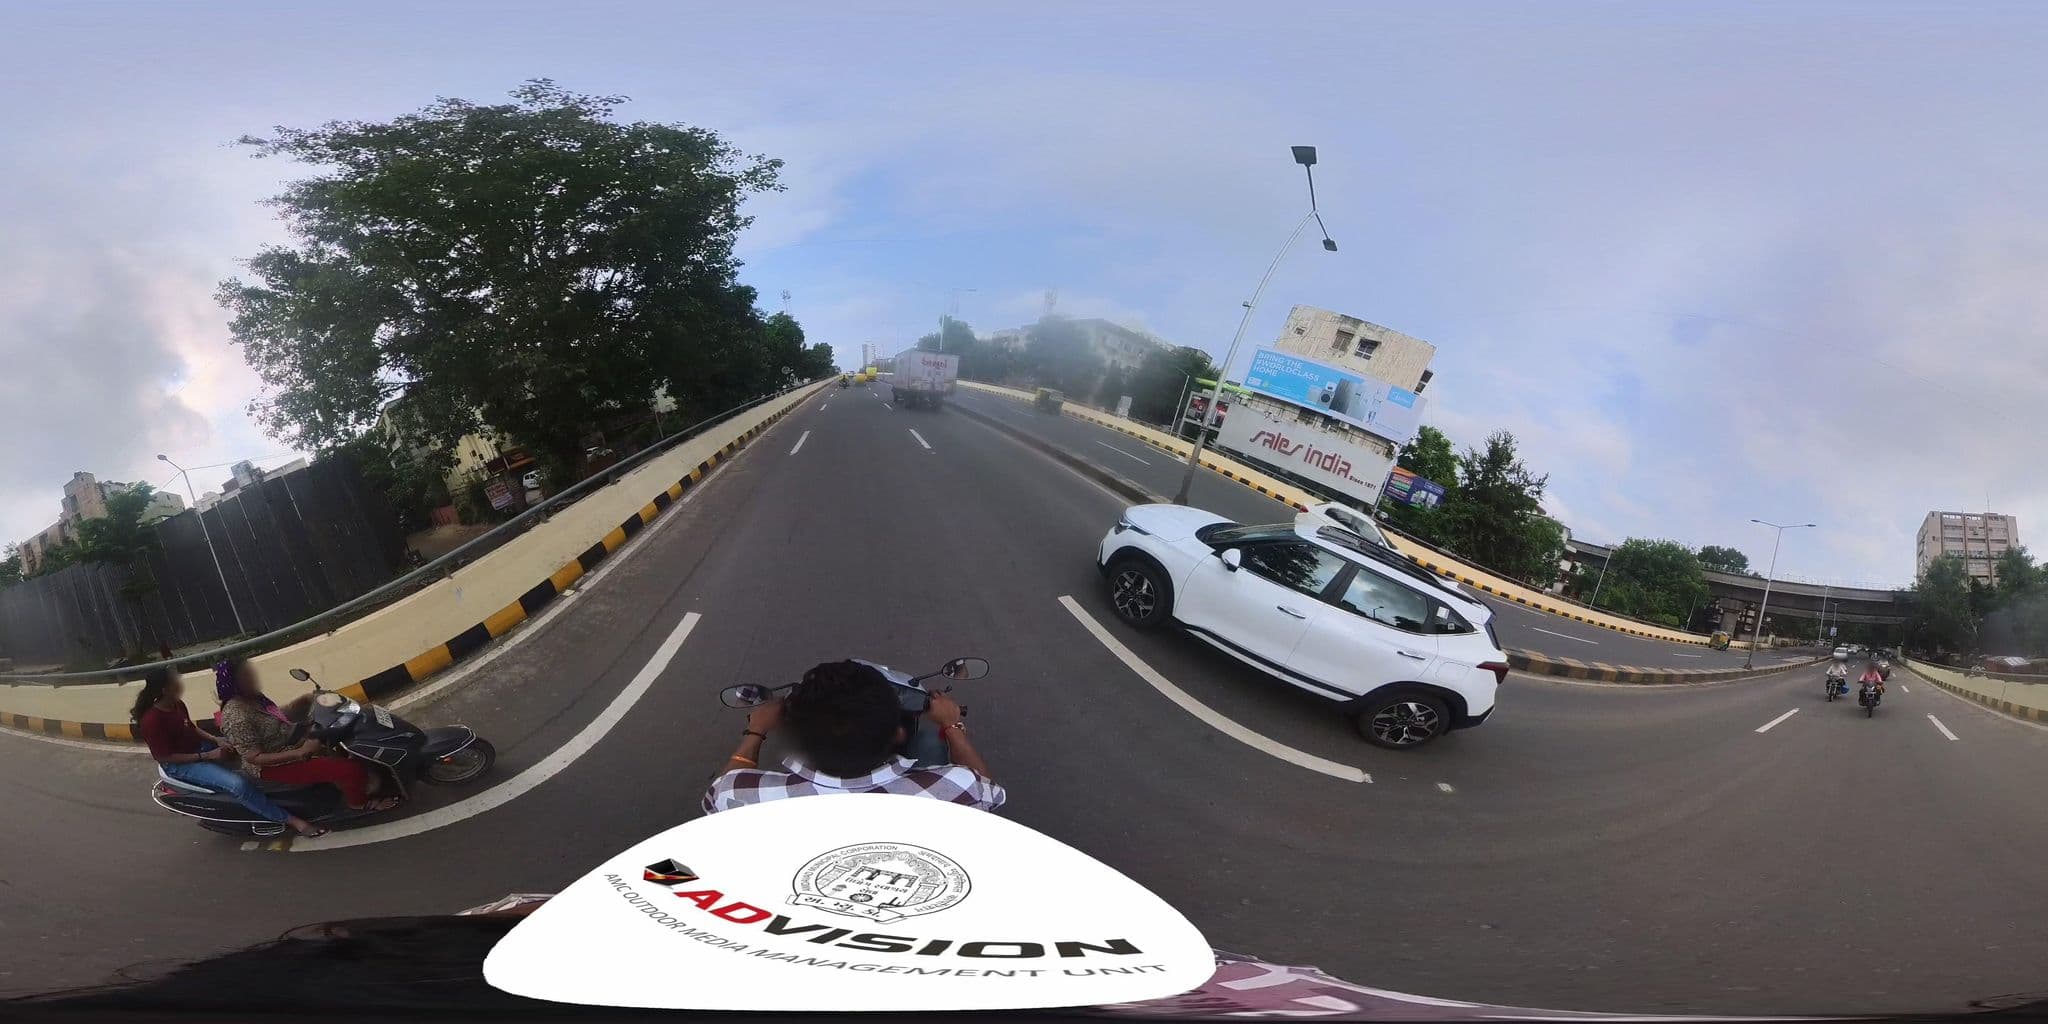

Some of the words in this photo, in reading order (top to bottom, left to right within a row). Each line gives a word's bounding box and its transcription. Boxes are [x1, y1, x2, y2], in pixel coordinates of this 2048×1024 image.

[1258, 352, 1284, 364] BRING
[1286, 359, 1304, 370] THE
[1253, 365, 1279, 377] HOME
